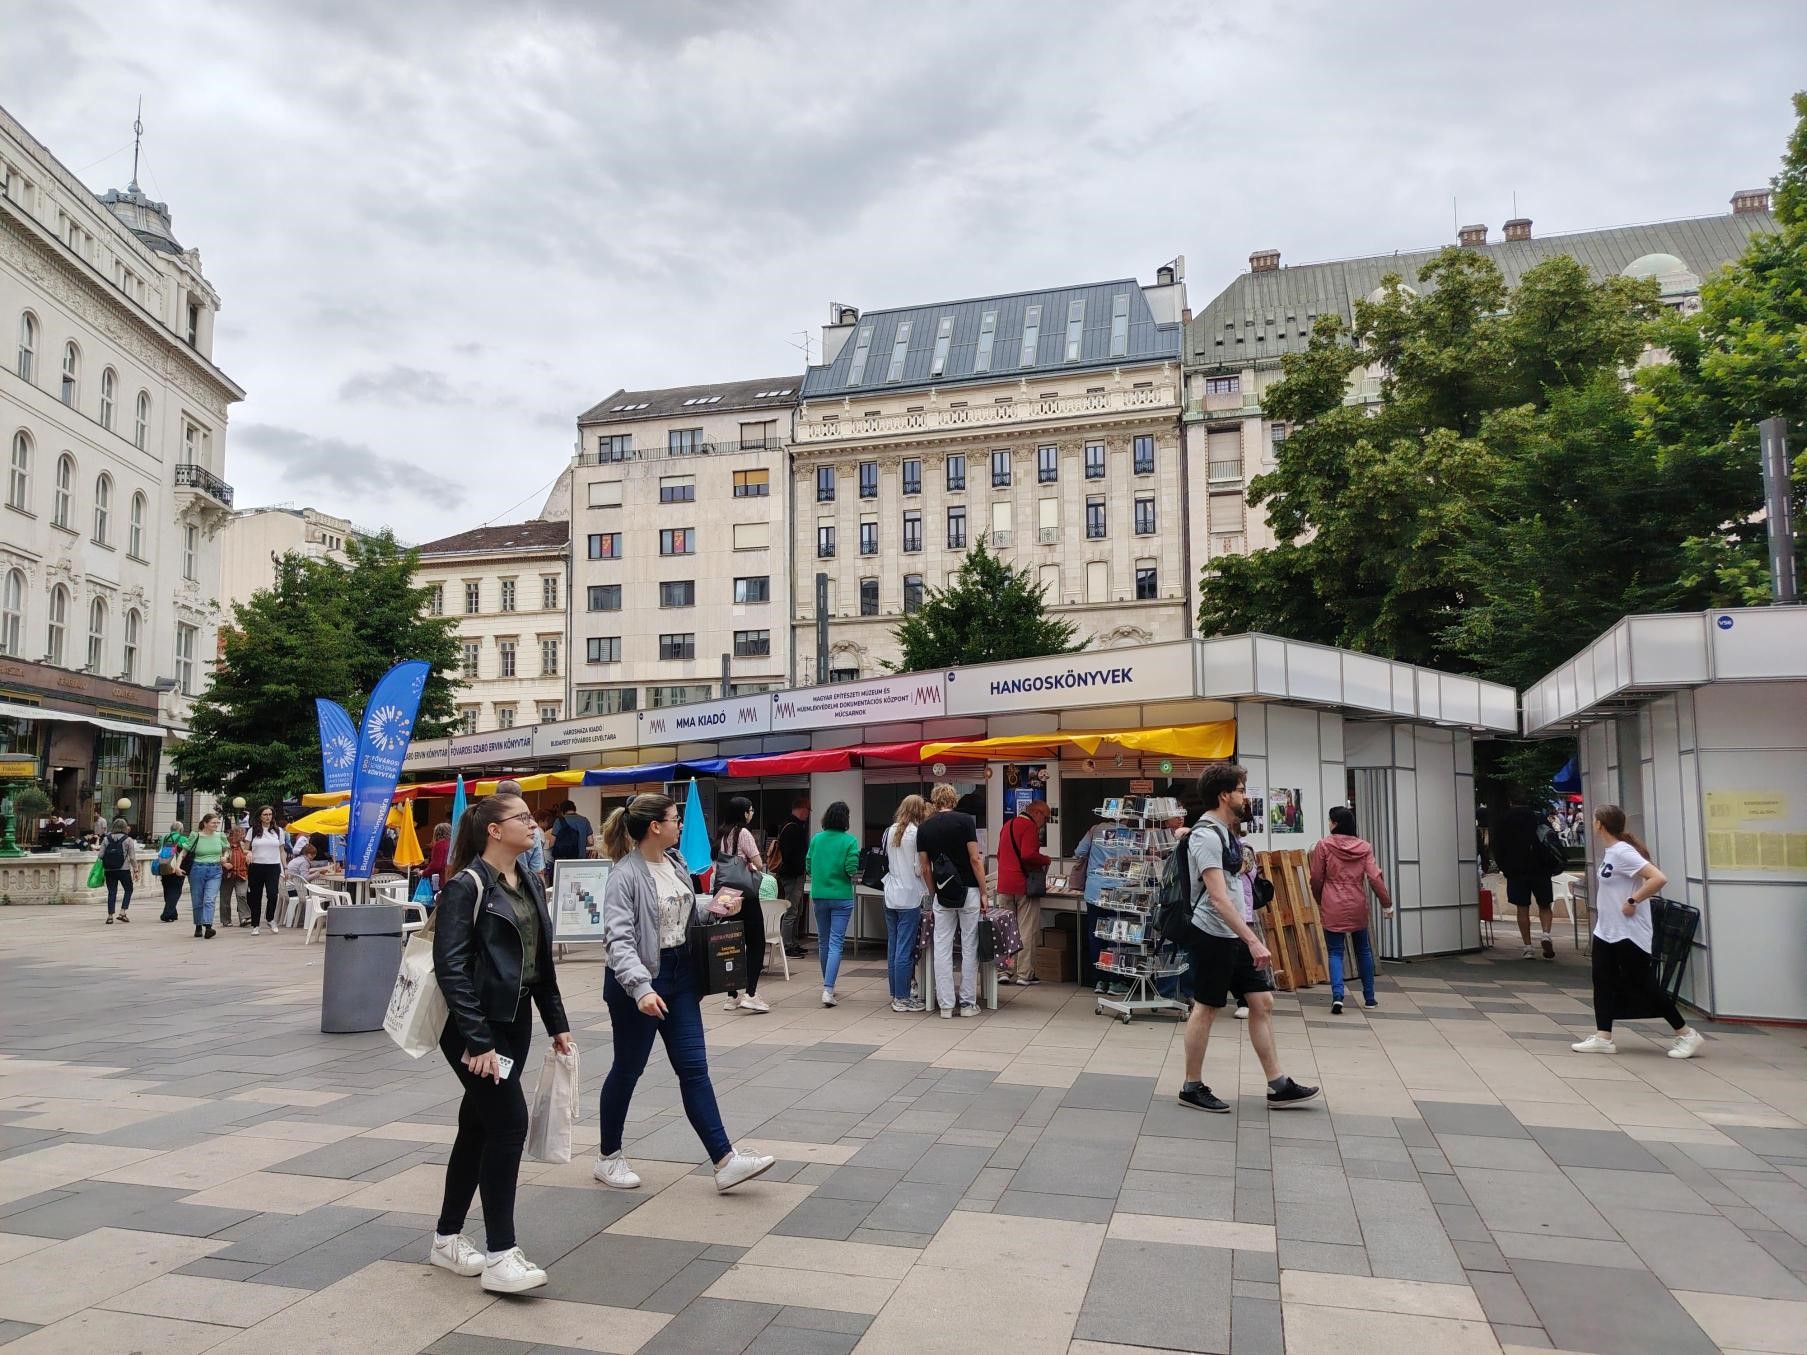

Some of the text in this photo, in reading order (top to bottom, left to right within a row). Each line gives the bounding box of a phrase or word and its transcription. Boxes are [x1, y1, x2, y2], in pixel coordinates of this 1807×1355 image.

[990, 667, 1133, 695] HANGOSKÖNYVEK
[813, 687, 890, 702] MAGYAR ÉPÍTÉSZETI MÚZEUM ÉS
[840, 697, 882, 708] DOKUMENTÁCIÓS
[883, 694, 909, 704] KÖZPONT
[676, 709, 726, 729] MMA KIADÓ
[834, 709, 866, 718] MŰCSARNOK
[589, 724, 603, 734] KIADÓ
[450, 736, 531, 757] FŐVÁROSI SZABÓ ERVIN KÖNYVTÁR
[551, 738, 571, 747] BUDAPEST
[414, 749, 427, 760] ERVIN
[426, 747, 449, 759] KÖNYVTÁR
[371, 755, 400, 767] FŐVÁROSI
[368, 769, 396, 779] KÖNYVTÁR
[360, 837, 376, 871] Budapest
